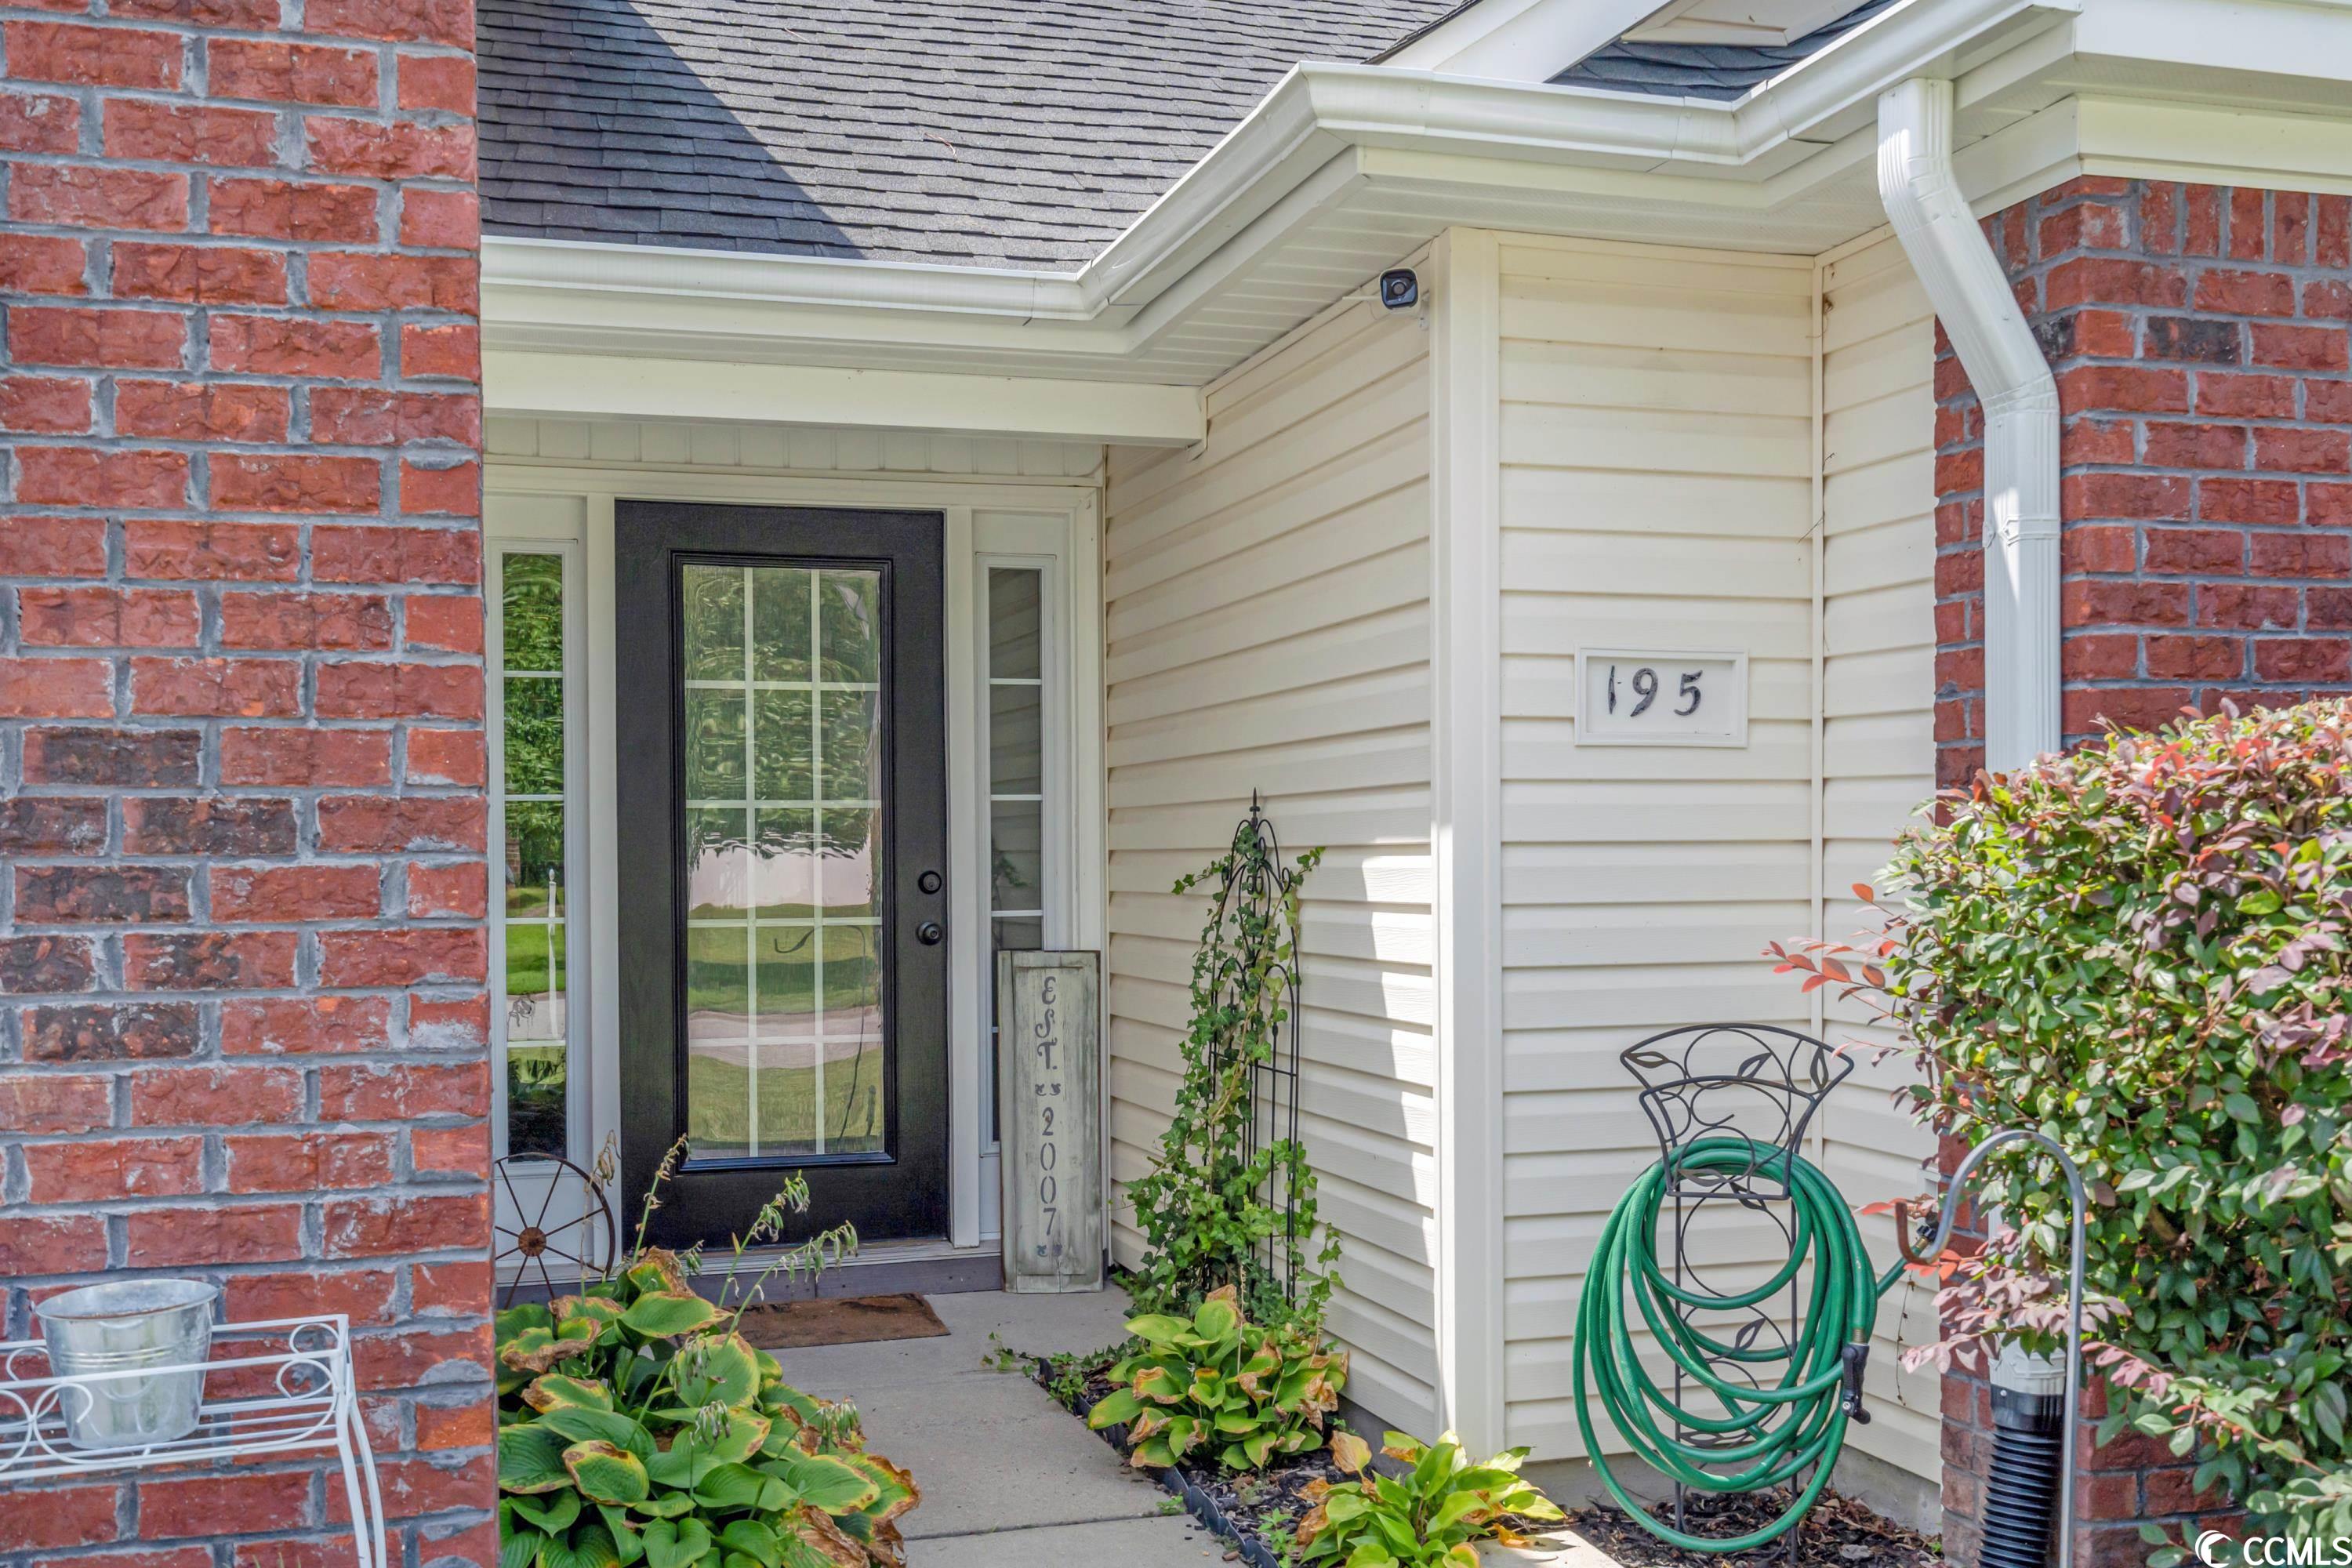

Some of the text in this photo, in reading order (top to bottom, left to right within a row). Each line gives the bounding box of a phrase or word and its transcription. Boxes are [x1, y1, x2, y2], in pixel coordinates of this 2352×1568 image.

[1608, 665, 1703, 717] 195
[1035, 975, 1058, 1236] EST. 2007
